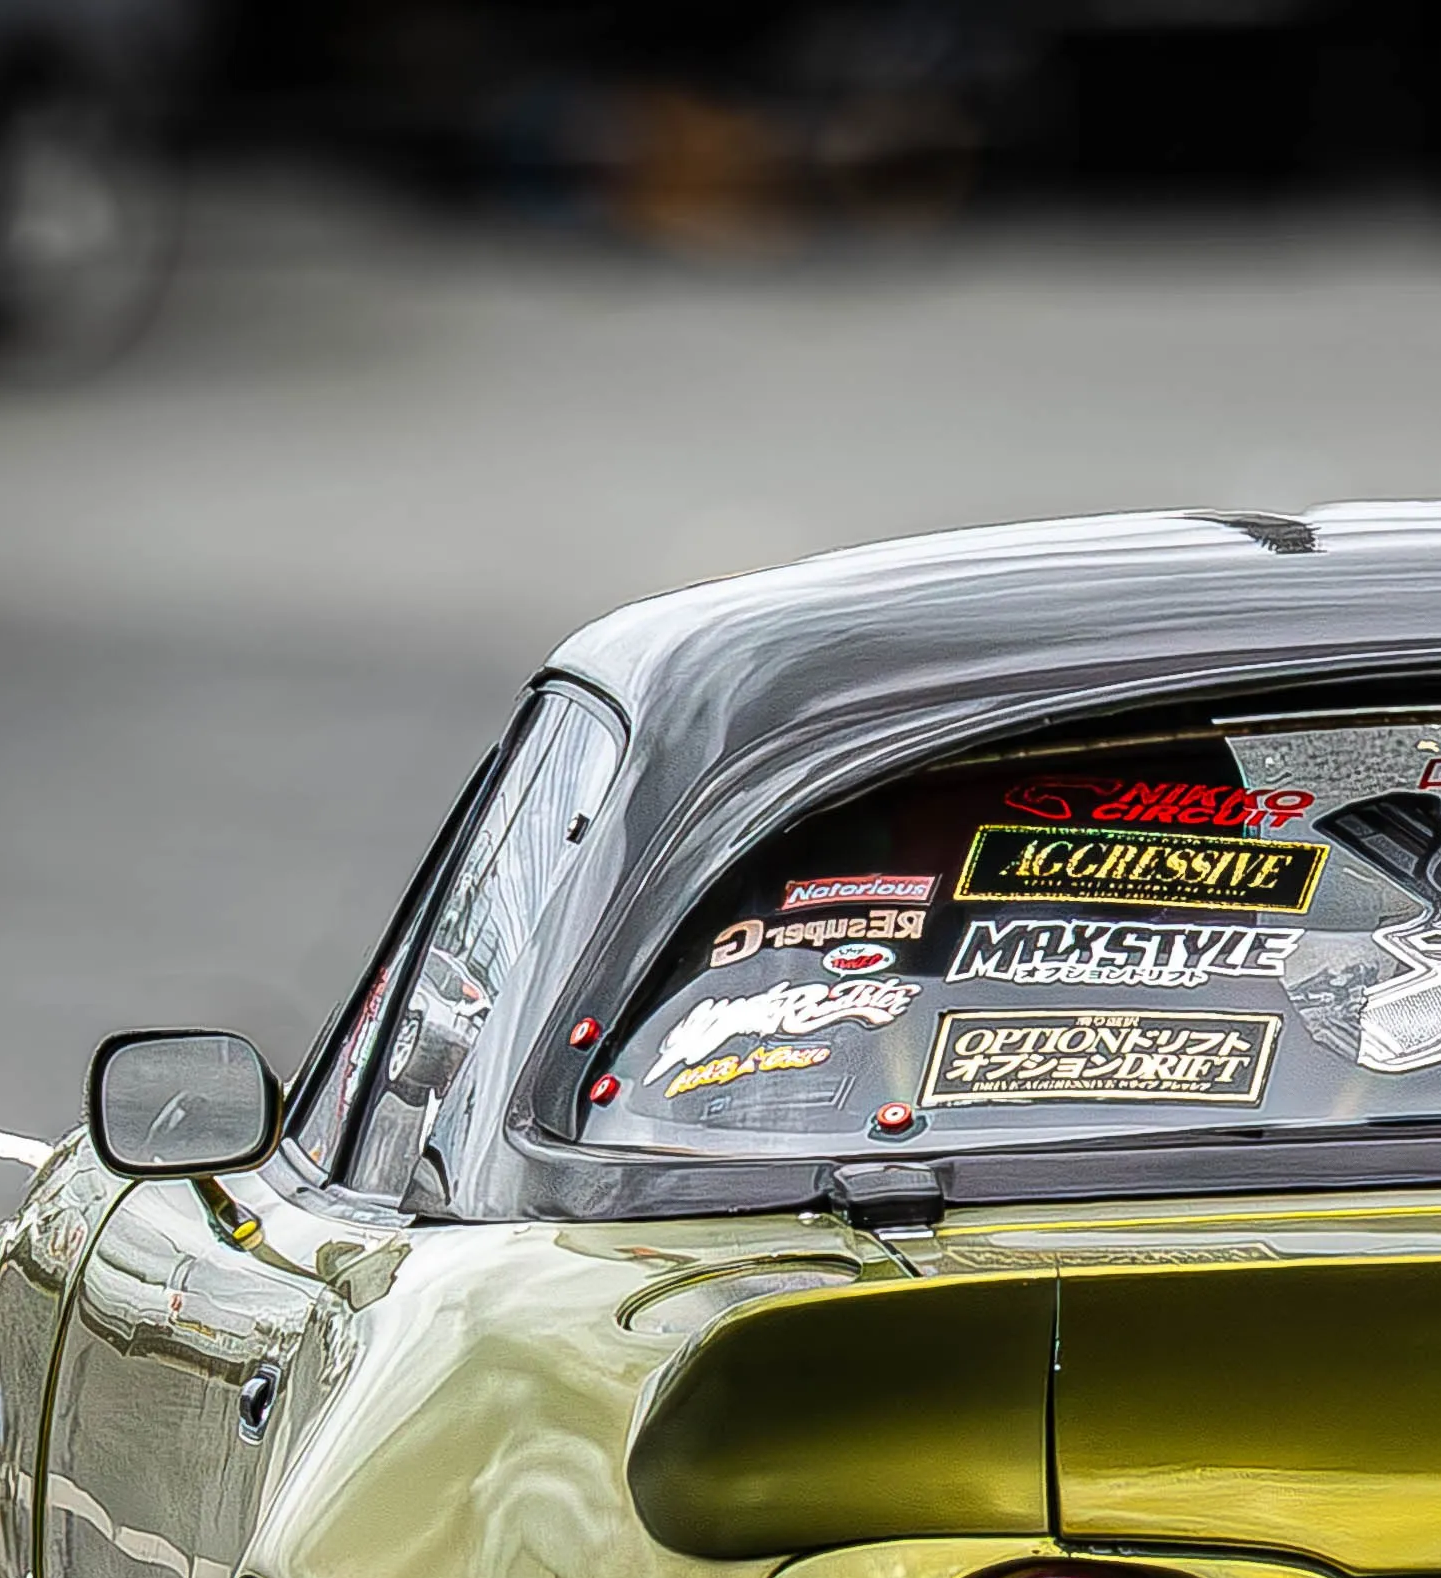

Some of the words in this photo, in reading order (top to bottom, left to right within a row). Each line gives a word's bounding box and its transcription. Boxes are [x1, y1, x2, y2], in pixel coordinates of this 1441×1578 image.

[1118, 782, 1315, 813] NIKKO
[1091, 802, 1304, 828] CIRCUIT
[999, 838, 1292, 890] AGGRESSIVE
[789, 879, 926, 904] Notorious
[945, 918, 1306, 983] MAXSTYLE
